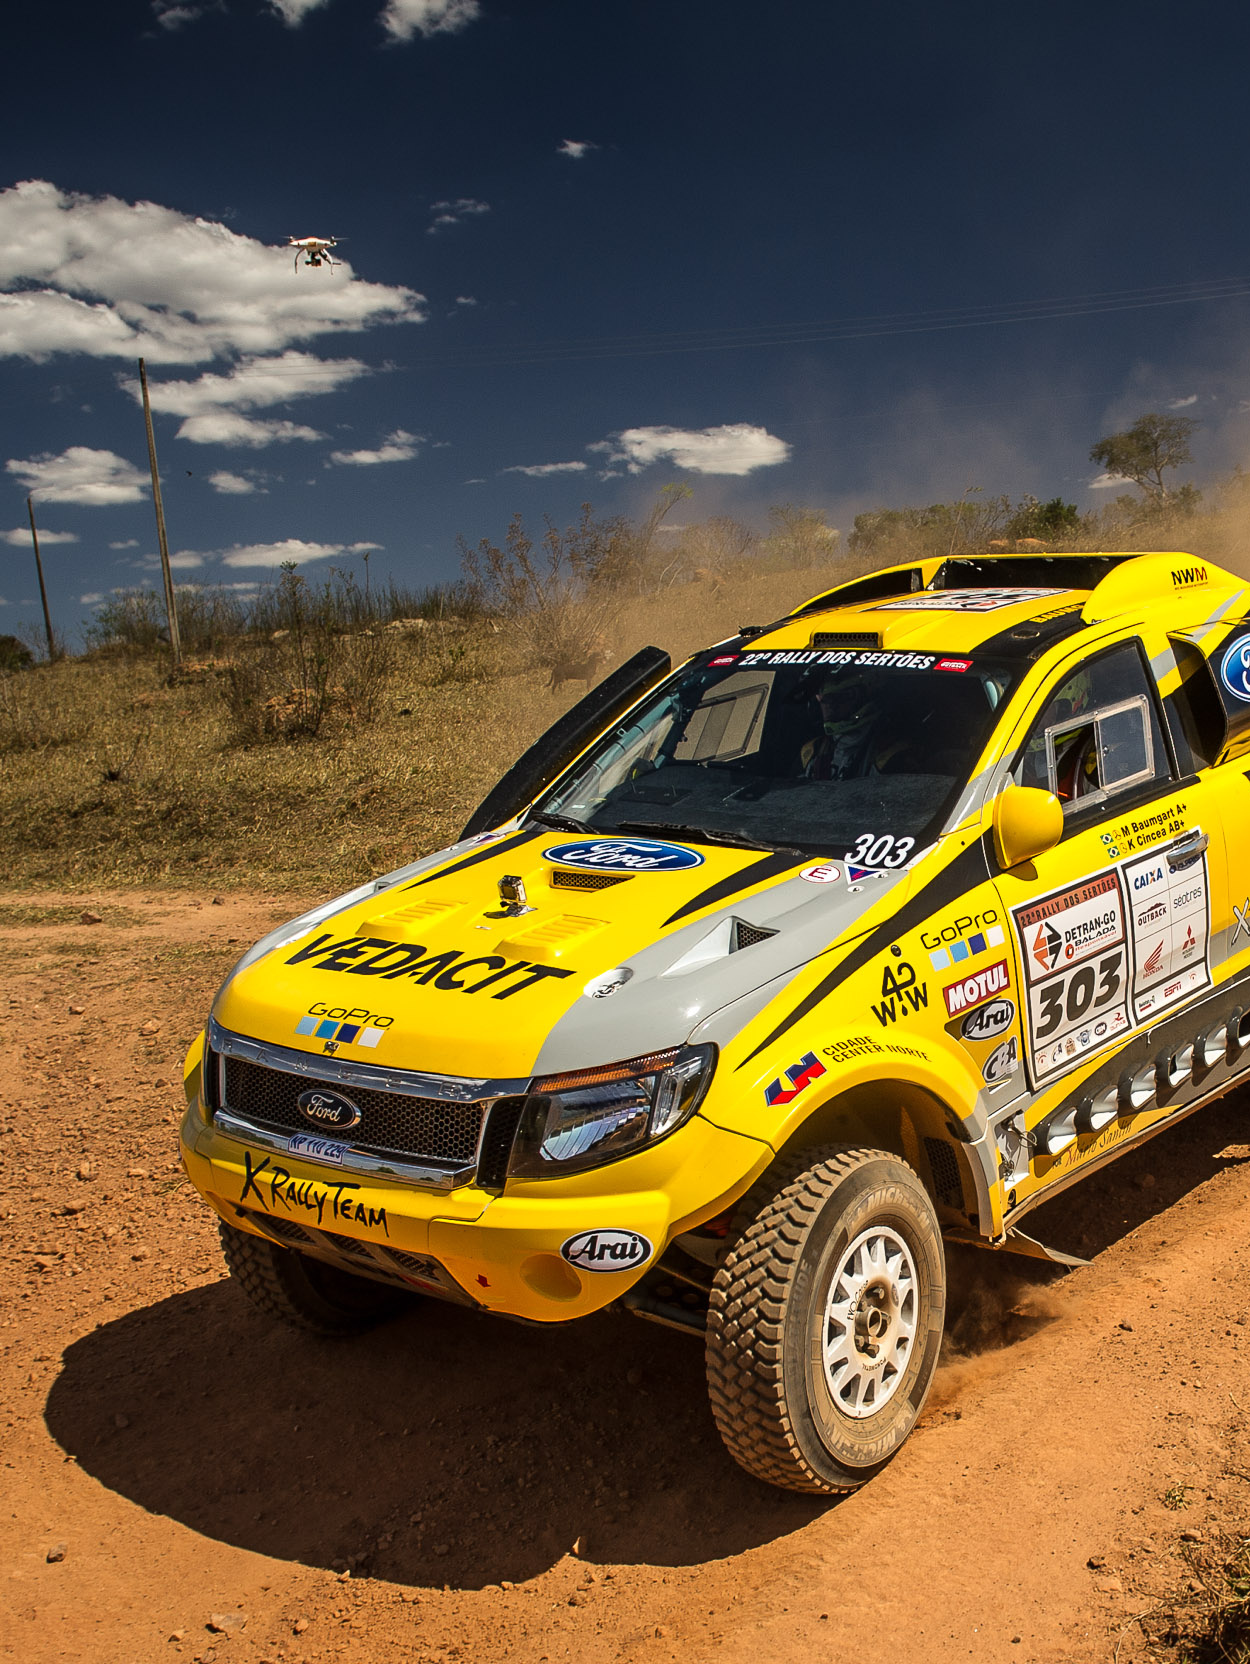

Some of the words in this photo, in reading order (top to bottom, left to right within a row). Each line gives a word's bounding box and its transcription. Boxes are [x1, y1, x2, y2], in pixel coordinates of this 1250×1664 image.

[1171, 566, 1208, 585] NWM
[767, 651, 815, 665] RALLY
[816, 651, 854, 665] DOS
[854, 649, 936, 671] SERTÕES
[1120, 825, 1131, 838] M
[1131, 807, 1176, 834] Baumgart
[1127, 838, 1136, 850] K
[1168, 819, 1185, 834] AB+
[563, 839, 668, 871] Ford
[844, 833, 917, 869] 303
[1133, 867, 1163, 890] CAIXA
[1063, 893, 1081, 909] DOS
[920, 909, 999, 950] GoPro
[1064, 910, 1117, 944] DETRAN-GO
[1137, 906, 1167, 927] OUTBACK
[1231, 896, 1250, 947] X
[1074, 925, 1117, 947] BALADA
[284, 934, 577, 1001] VEDACIT
[948, 963, 1008, 1016] MOTUL
[1035, 950, 1124, 1040] 303
[1164, 981, 1182, 998] ESPN
[308, 1001, 395, 1029] GoPro
[965, 1002, 1012, 1037] Arai
[821, 1035, 878, 1057] CIDADE
[832, 1043, 884, 1064] CENTER
[884, 1044, 933, 1063] NORTE
[306, 1094, 343, 1122] Ford
[238, 1150, 273, 1212] X
[271, 1166, 329, 1225] RALLY
[326, 1180, 390, 1238] TEAM
[574, 1233, 642, 1263] Arai
